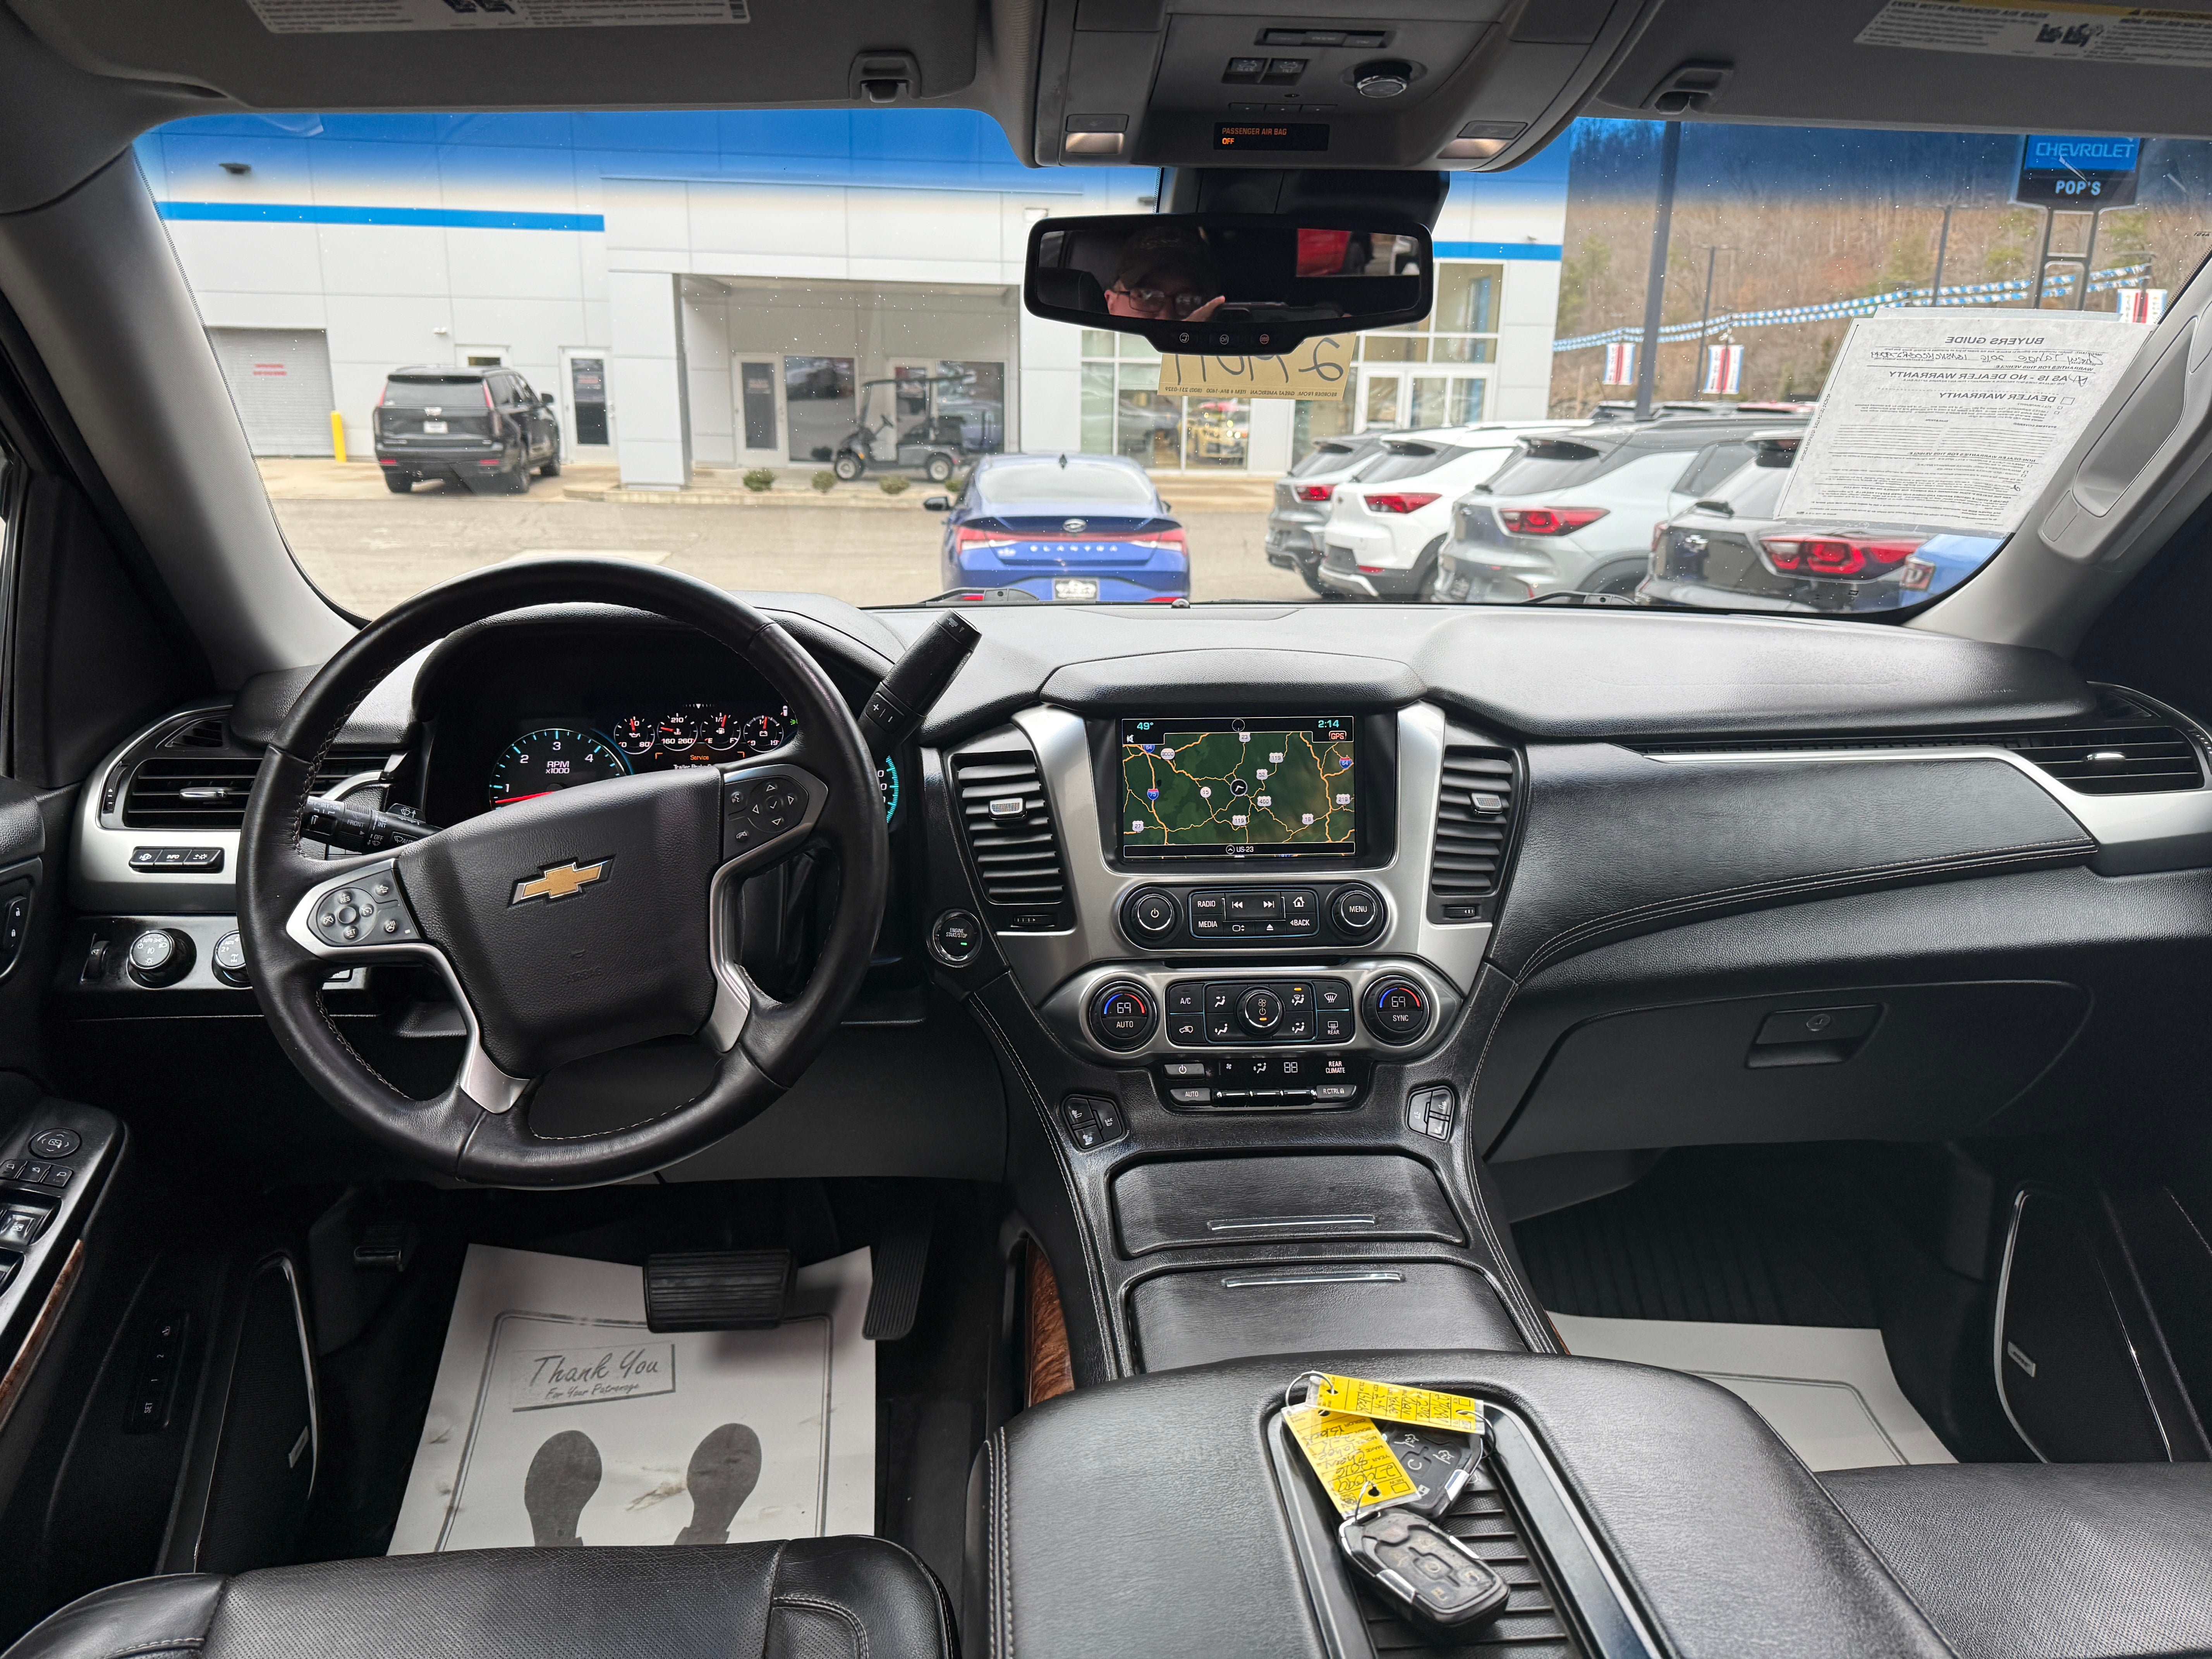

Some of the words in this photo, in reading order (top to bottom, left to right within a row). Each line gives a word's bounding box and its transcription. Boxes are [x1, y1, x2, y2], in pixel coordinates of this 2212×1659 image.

[2036, 143, 2134, 158] CHEVROLET
[2055, 180, 2101, 196] POP'S
[1137, 722, 1154, 730] 49°
[1318, 720, 1340, 728] 2:14
[553, 742, 561, 750] 3
[520, 755, 529, 763] 2
[585, 754, 593, 763] 4
[505, 783, 510, 792] 1
[347, 819, 364, 828] FRONT
[1391, 996, 1405, 1007] 69
[1117, 1002, 1131, 1013] 69
[529, 1352, 613, 1387] Thank
[620, 1348, 659, 1379] You
[545, 1387, 564, 1399] For
[567, 1386, 589, 1398] Your
[144, 1401, 153, 1413] SET
[1345, 1419, 1366, 1427] COLOR
